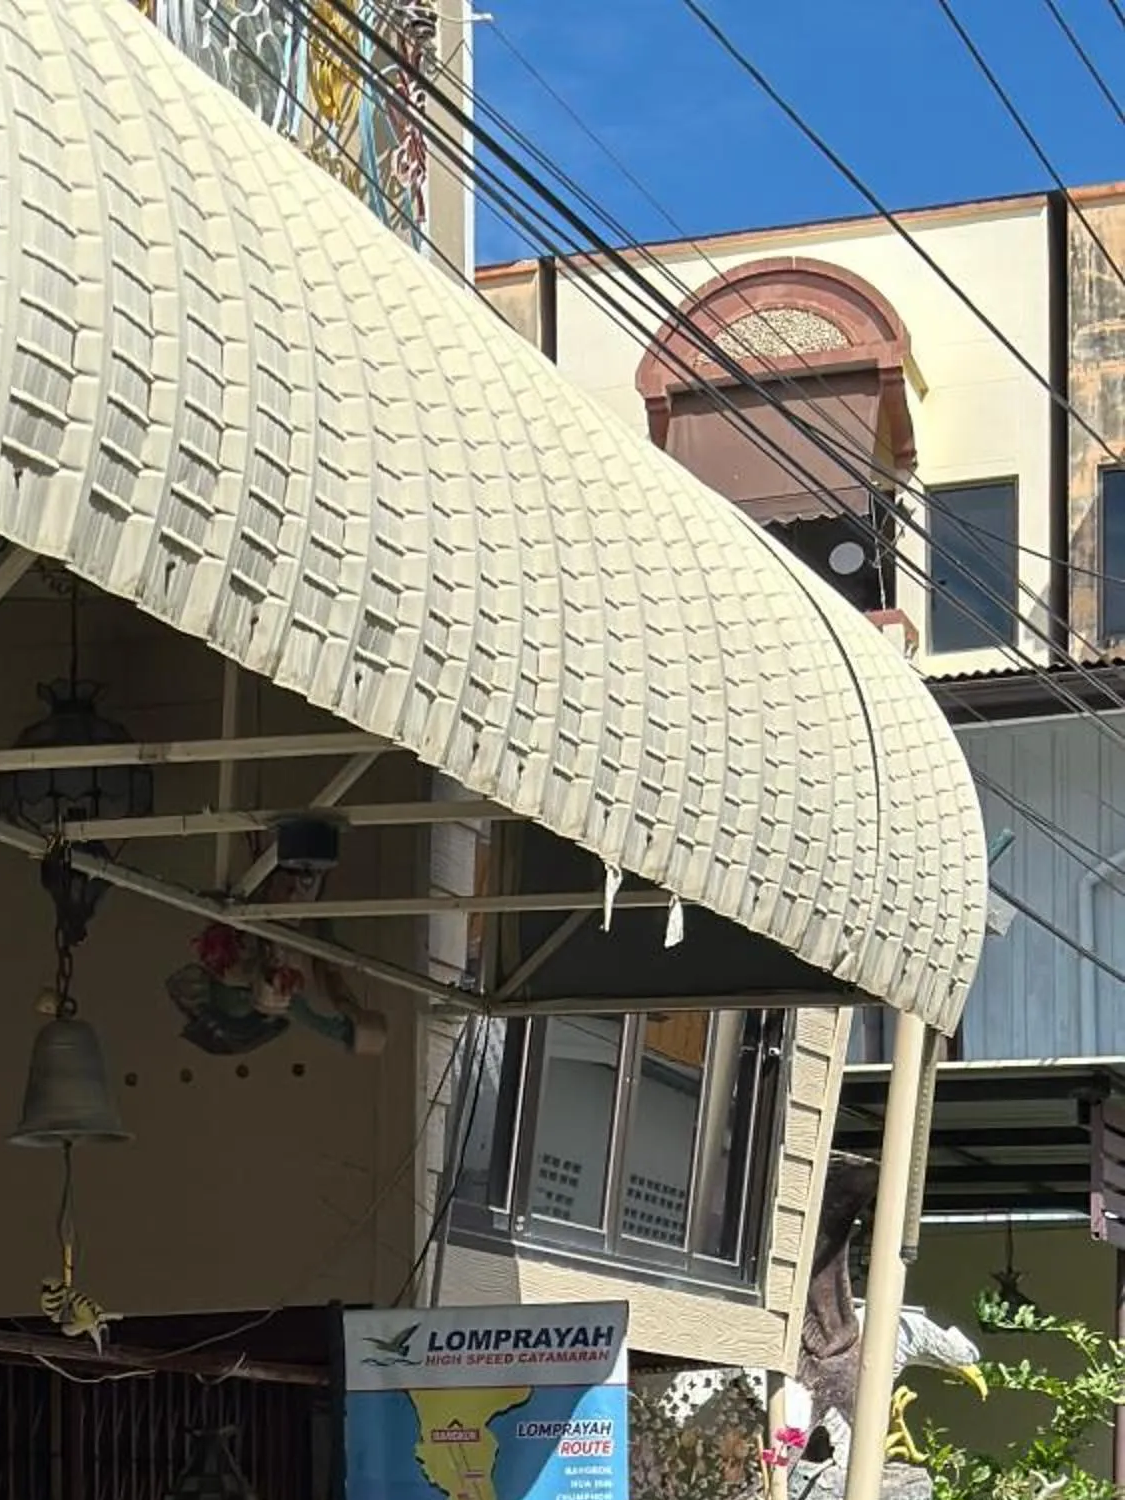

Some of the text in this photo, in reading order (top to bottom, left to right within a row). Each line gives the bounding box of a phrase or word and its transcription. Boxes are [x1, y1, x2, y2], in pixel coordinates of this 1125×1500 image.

[427, 1326, 615, 1353] LOMPRAYAH
[425, 1350, 610, 1367] HIGH SPEED CATAMARAN
[517, 1421, 613, 1438] LOMPRAYAH
[559, 1439, 613, 1456] ROUTE
